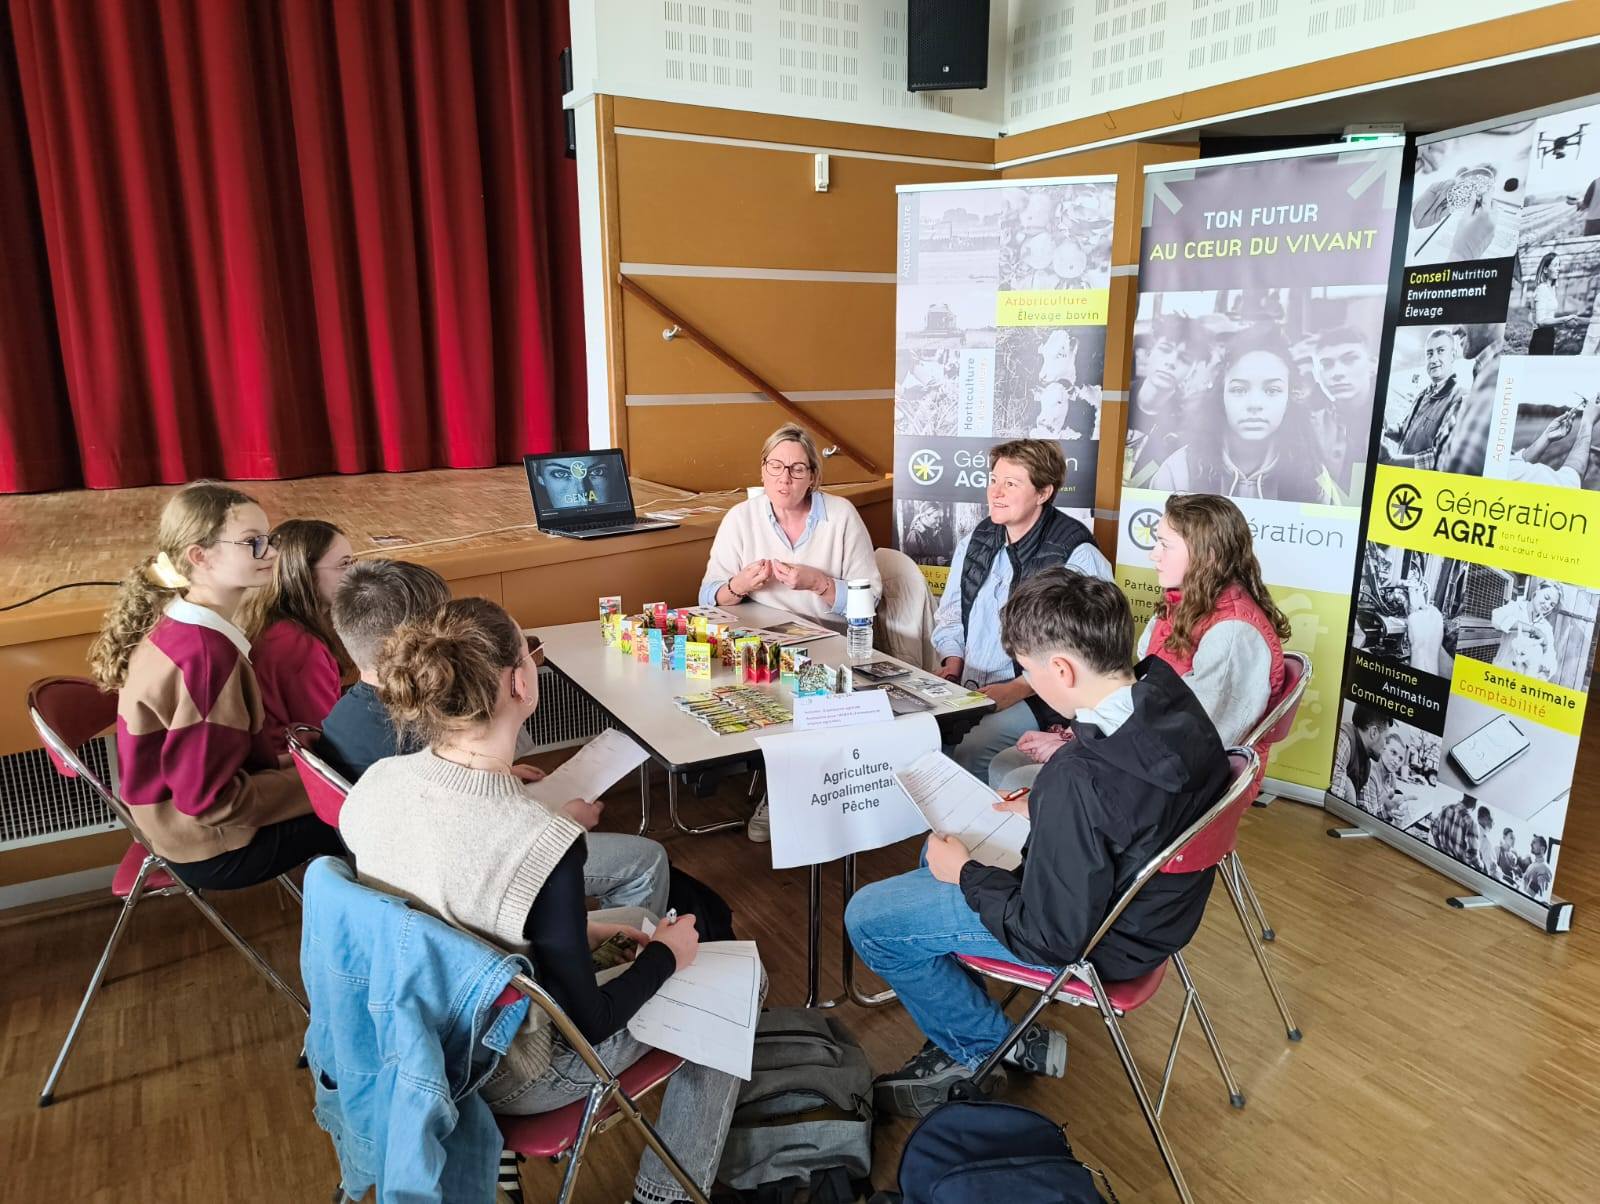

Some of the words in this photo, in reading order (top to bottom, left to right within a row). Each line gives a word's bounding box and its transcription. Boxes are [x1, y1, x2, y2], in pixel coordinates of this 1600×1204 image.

[1204, 210, 1242, 230] TON
[1251, 204, 1318, 227] FUTUR
[1150, 243, 1177, 261] AU
[1184, 238, 1241, 259] CŒUR
[1250, 236, 1278, 256] DU
[1287, 229, 1378, 252] VIVANT
[1409, 269, 1450, 285] Conseil
[1452, 267, 1498, 281] Nutrition
[1004, 296, 1088, 307] Arboriculture
[1407, 285, 1487, 301] Environnement
[1066, 311, 1099, 321] bovin
[1405, 303, 1443, 317] Élevage
[964, 358, 975, 430] Horticulture
[1436, 488, 1588, 535] Génération
[1433, 516, 1497, 548] AGRI
[1501, 531, 1515, 540] ton
[1517, 534, 1538, 544] futur
[1537, 551, 1548, 559] du
[1551, 554, 1580, 564] vivant
[1355, 655, 1418, 686] Machinisme
[1351, 683, 1415, 717] Commerce
[1382, 682, 1441, 712] Animation
[1459, 679, 1547, 718] Comptabilité
[1484, 670, 1516, 691] Santé
[1521, 684, 1576, 709] animale
[852, 748, 860, 760] 6
[823, 761, 893, 785] Agriculture,
[842, 798, 880, 814] Pêche
